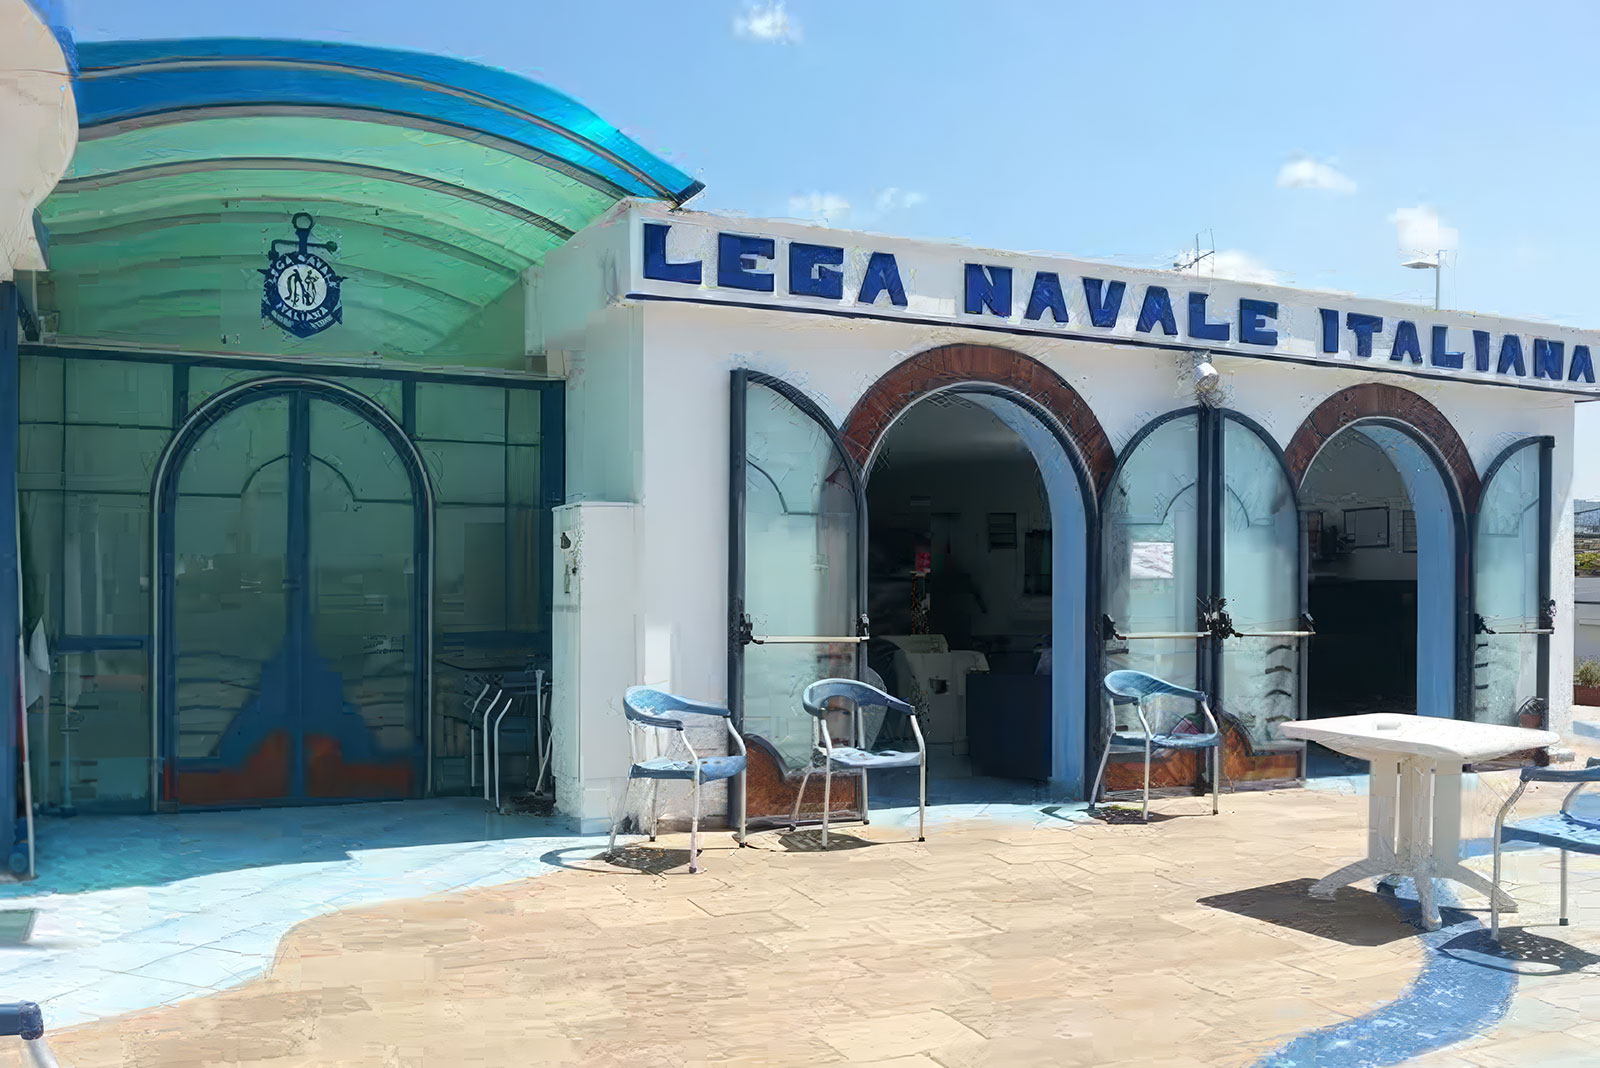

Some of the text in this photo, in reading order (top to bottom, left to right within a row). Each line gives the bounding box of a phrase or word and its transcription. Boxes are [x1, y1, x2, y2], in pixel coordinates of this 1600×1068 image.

[642, 222, 1596, 384] LEGA NAVALE ITALIANA
